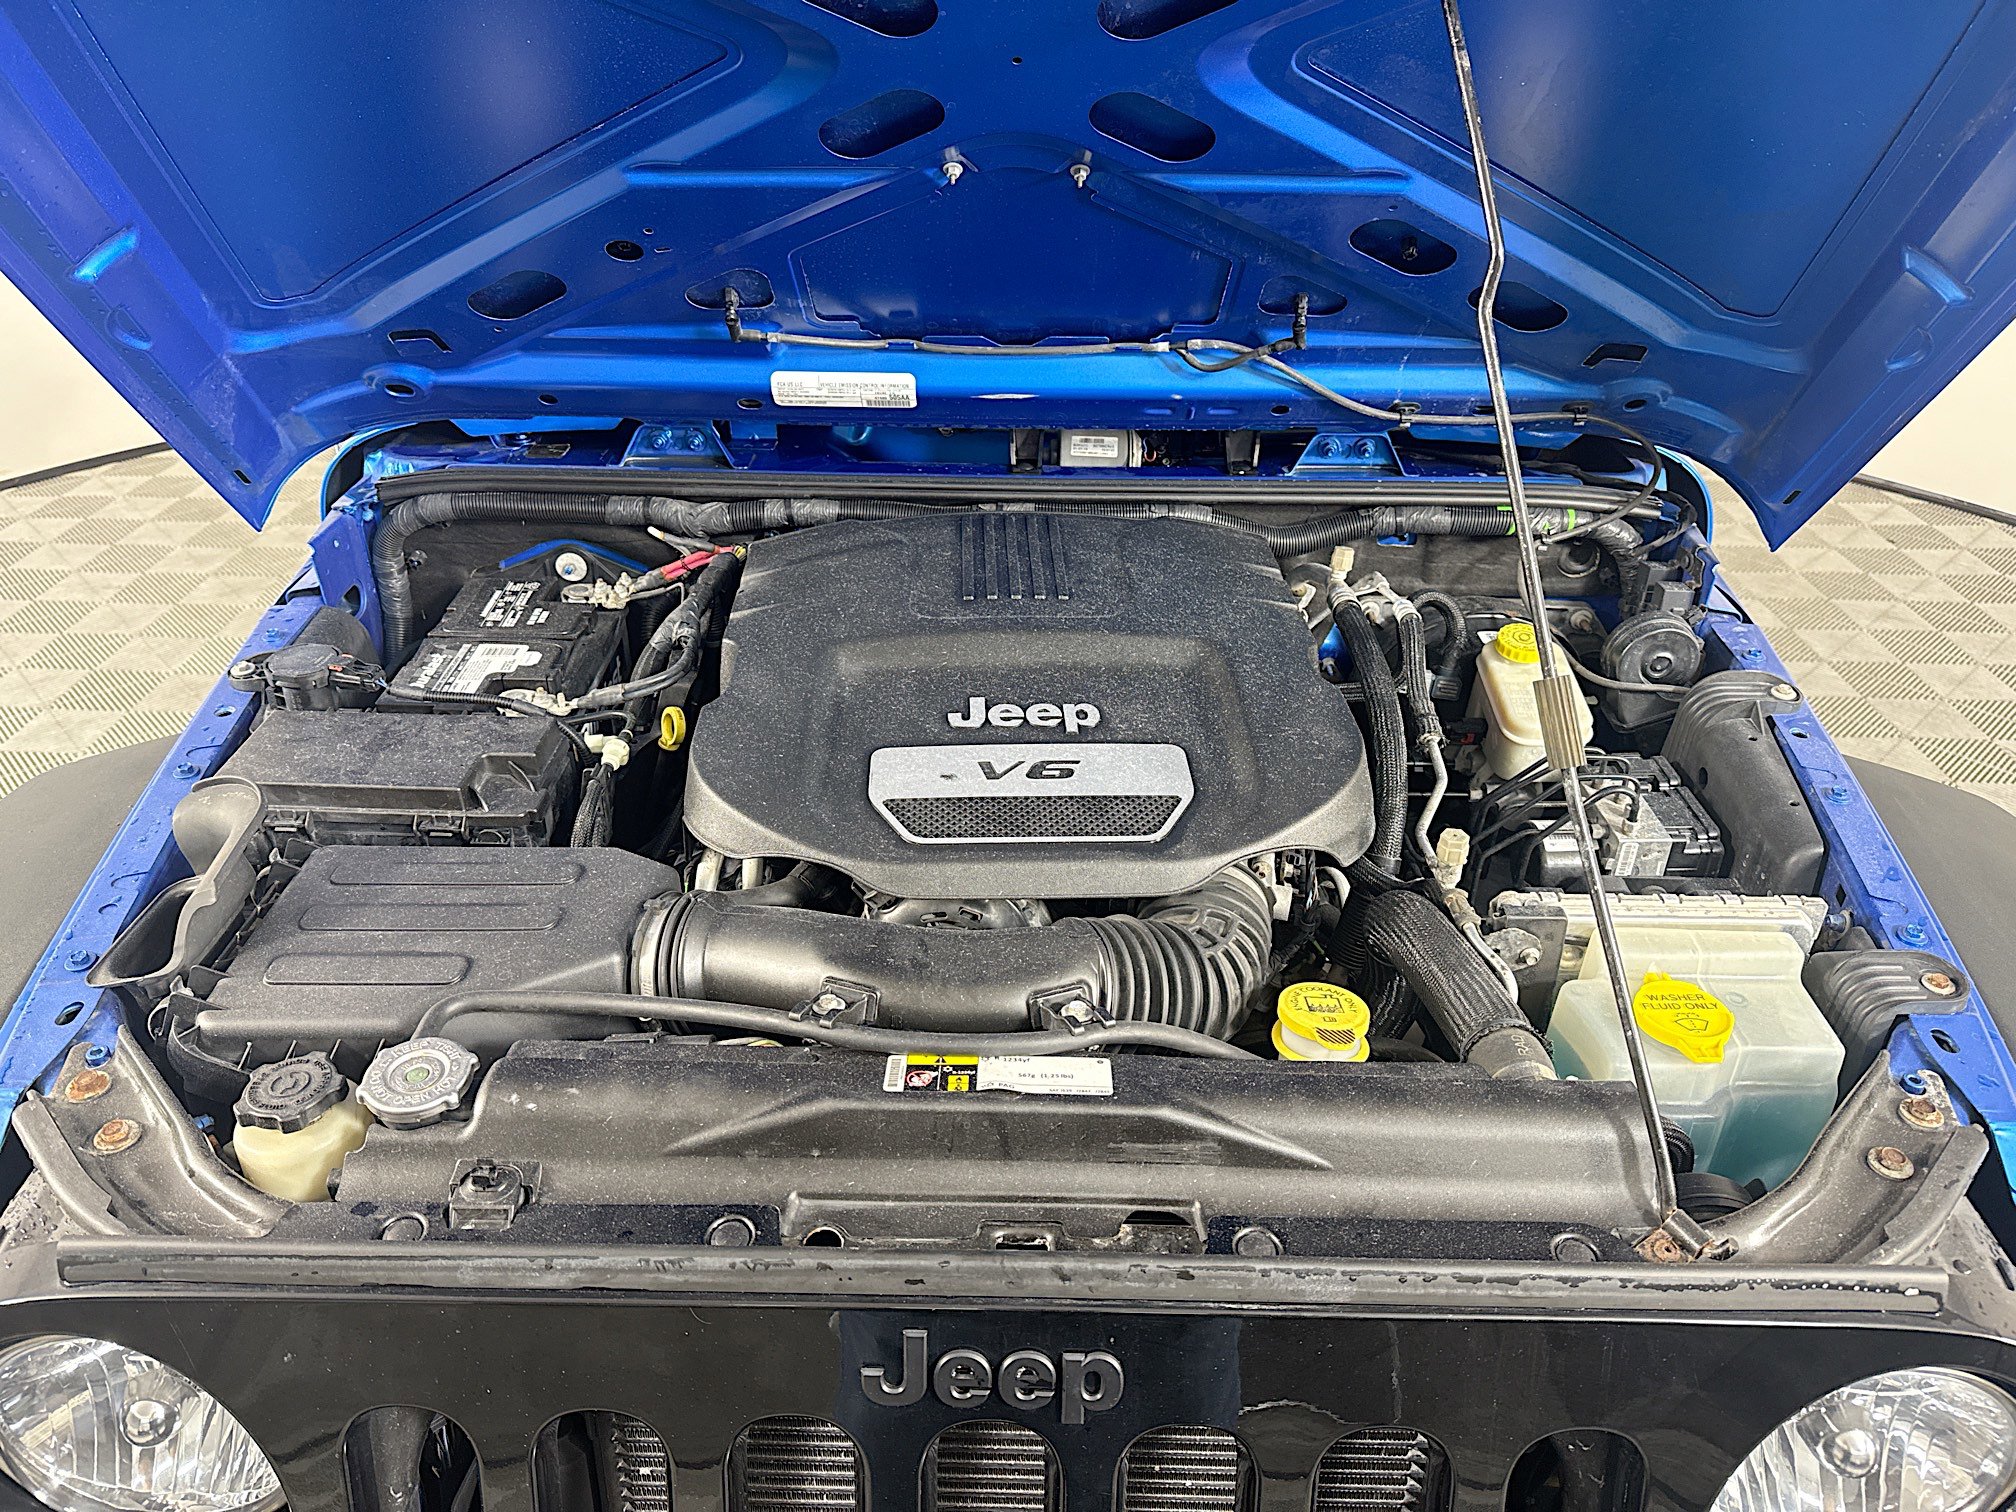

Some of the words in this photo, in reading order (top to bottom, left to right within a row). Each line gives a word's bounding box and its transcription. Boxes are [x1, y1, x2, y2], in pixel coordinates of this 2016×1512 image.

[947, 696, 1101, 734] Jeep
[977, 760, 1081, 780] V6
[1300, 986, 1345, 997] COOLANT
[391, 1040, 430, 1057] KEEP
[860, 1327, 1125, 1425] Jeep
